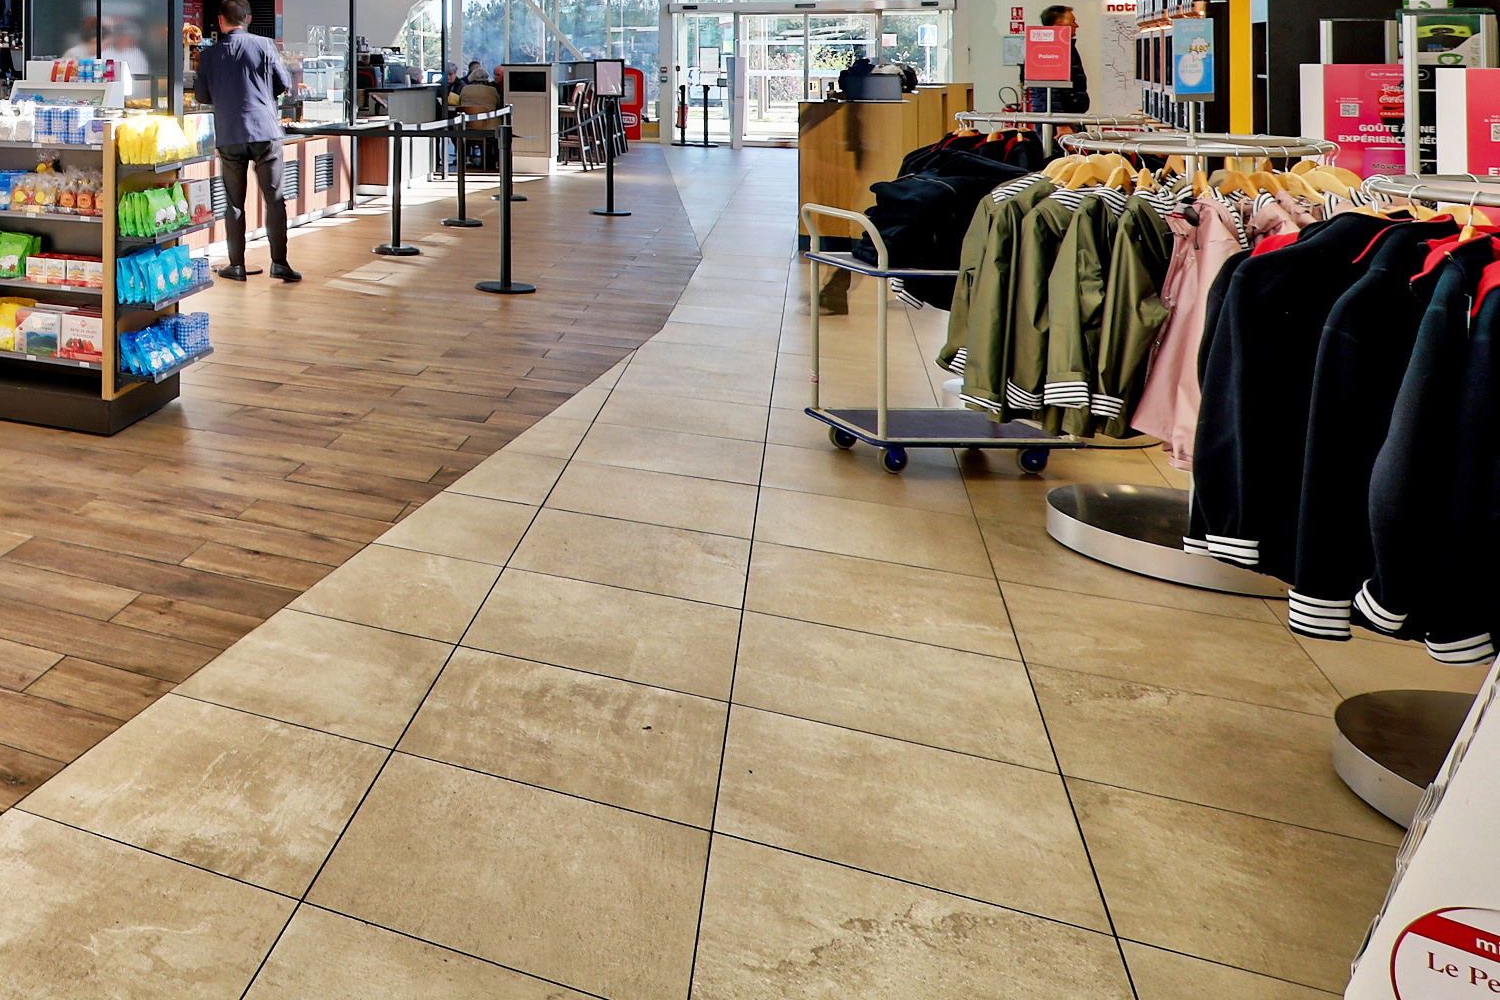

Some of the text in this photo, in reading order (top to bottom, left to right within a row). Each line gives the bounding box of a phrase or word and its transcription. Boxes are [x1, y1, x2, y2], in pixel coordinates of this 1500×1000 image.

[1107, 2, 1137, 12] notr
[1358, 123, 1399, 132] GOÛTE
[1427, 951, 1459, 978] Le
